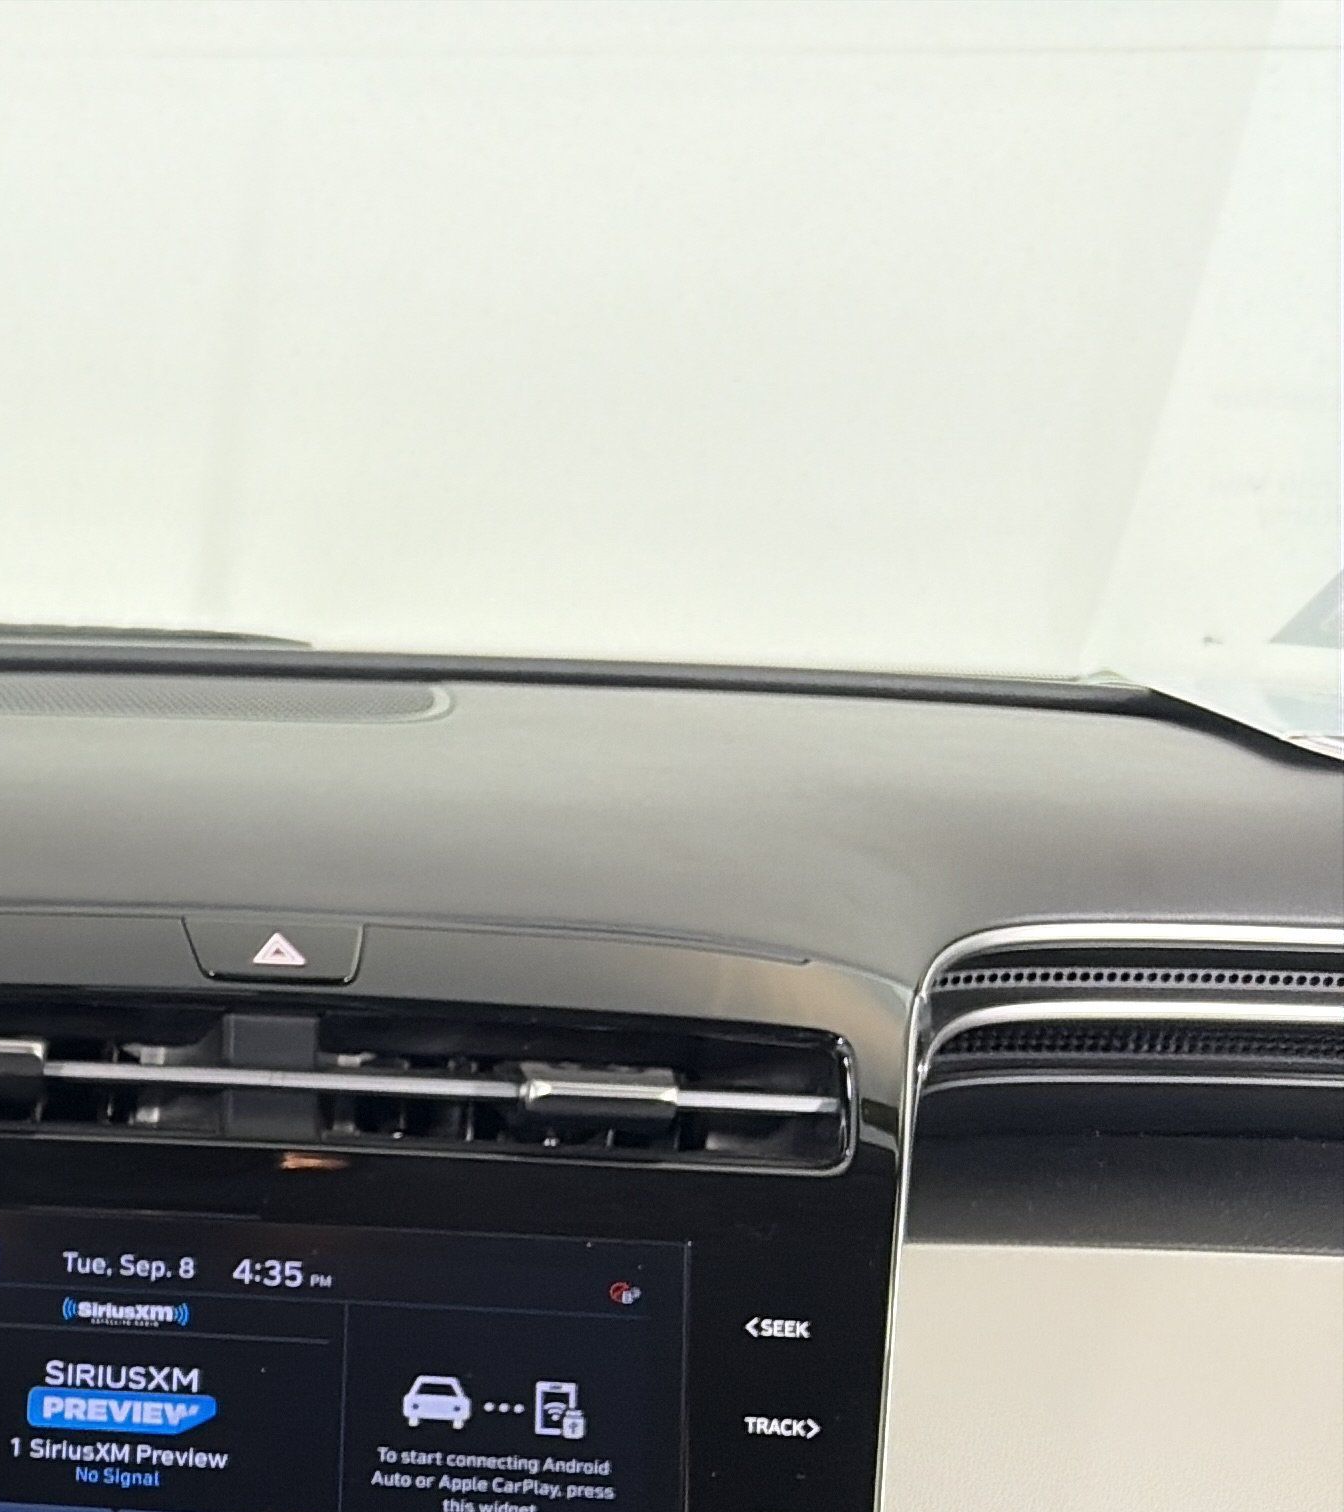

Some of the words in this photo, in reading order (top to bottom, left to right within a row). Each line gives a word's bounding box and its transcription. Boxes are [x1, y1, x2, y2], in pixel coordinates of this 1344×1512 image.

[119, 1253, 172, 1282] Sep.
[178, 1256, 195, 1279] 8
[232, 1258, 303, 1288] 4:35
[310, 1274, 333, 1288] PM
[760, 1320, 811, 1339] SEEK
[44, 1359, 199, 1393] SIRIUSXM
[43, 1396, 199, 1426] PREVIEW
[744, 1416, 807, 1437] TRACK
[11, 1438, 22, 1458] 1
[29, 1440, 129, 1463] SiriusXM
[136, 1446, 229, 1470] Preview
[377, 1446, 398, 1463] To
[400, 1450, 442, 1466] start
[446, 1453, 540, 1475] connecting
[542, 1456, 611, 1475] Android
[75, 1467, 98, 1483] No
[103, 1468, 160, 1488] Signal
[370, 1470, 412, 1488] Auto
[415, 1475, 435, 1489] or
[438, 1474, 489, 1493] Apple
[566, 1484, 616, 1500] press
